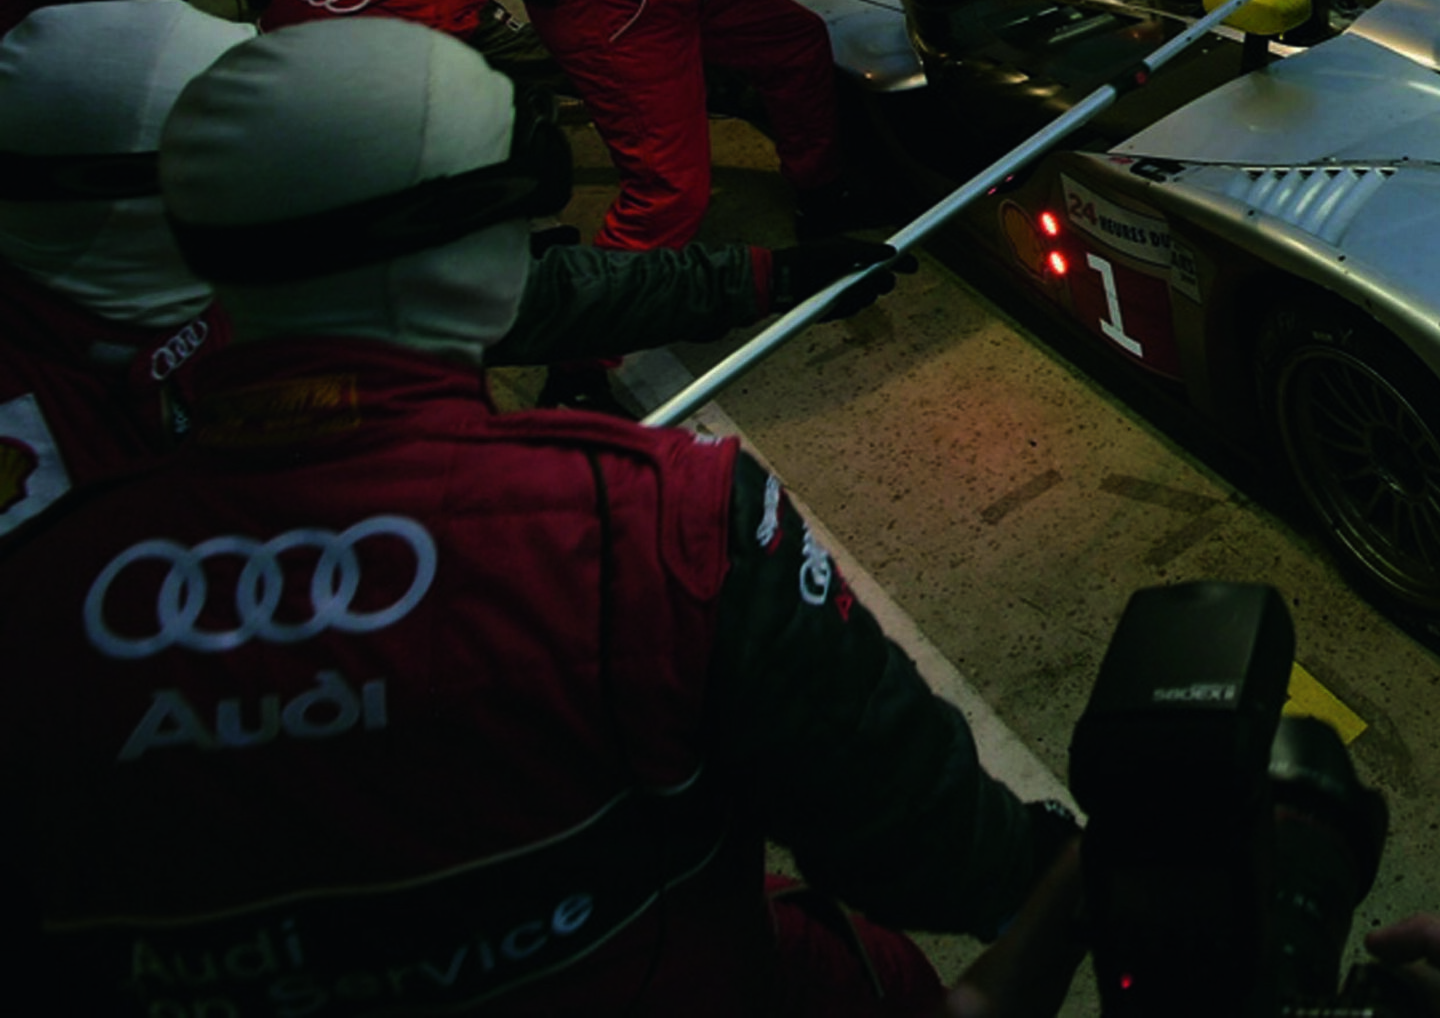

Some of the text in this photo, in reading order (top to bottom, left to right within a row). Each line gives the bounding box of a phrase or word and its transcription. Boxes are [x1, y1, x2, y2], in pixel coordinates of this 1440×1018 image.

[1068, 192, 1098, 226] 24
[1099, 214, 1147, 245] HEURES
[1086, 252, 1144, 359] 1
[117, 668, 388, 763] Audi
[130, 916, 305, 988] Audi
[267, 891, 596, 1018] Service
